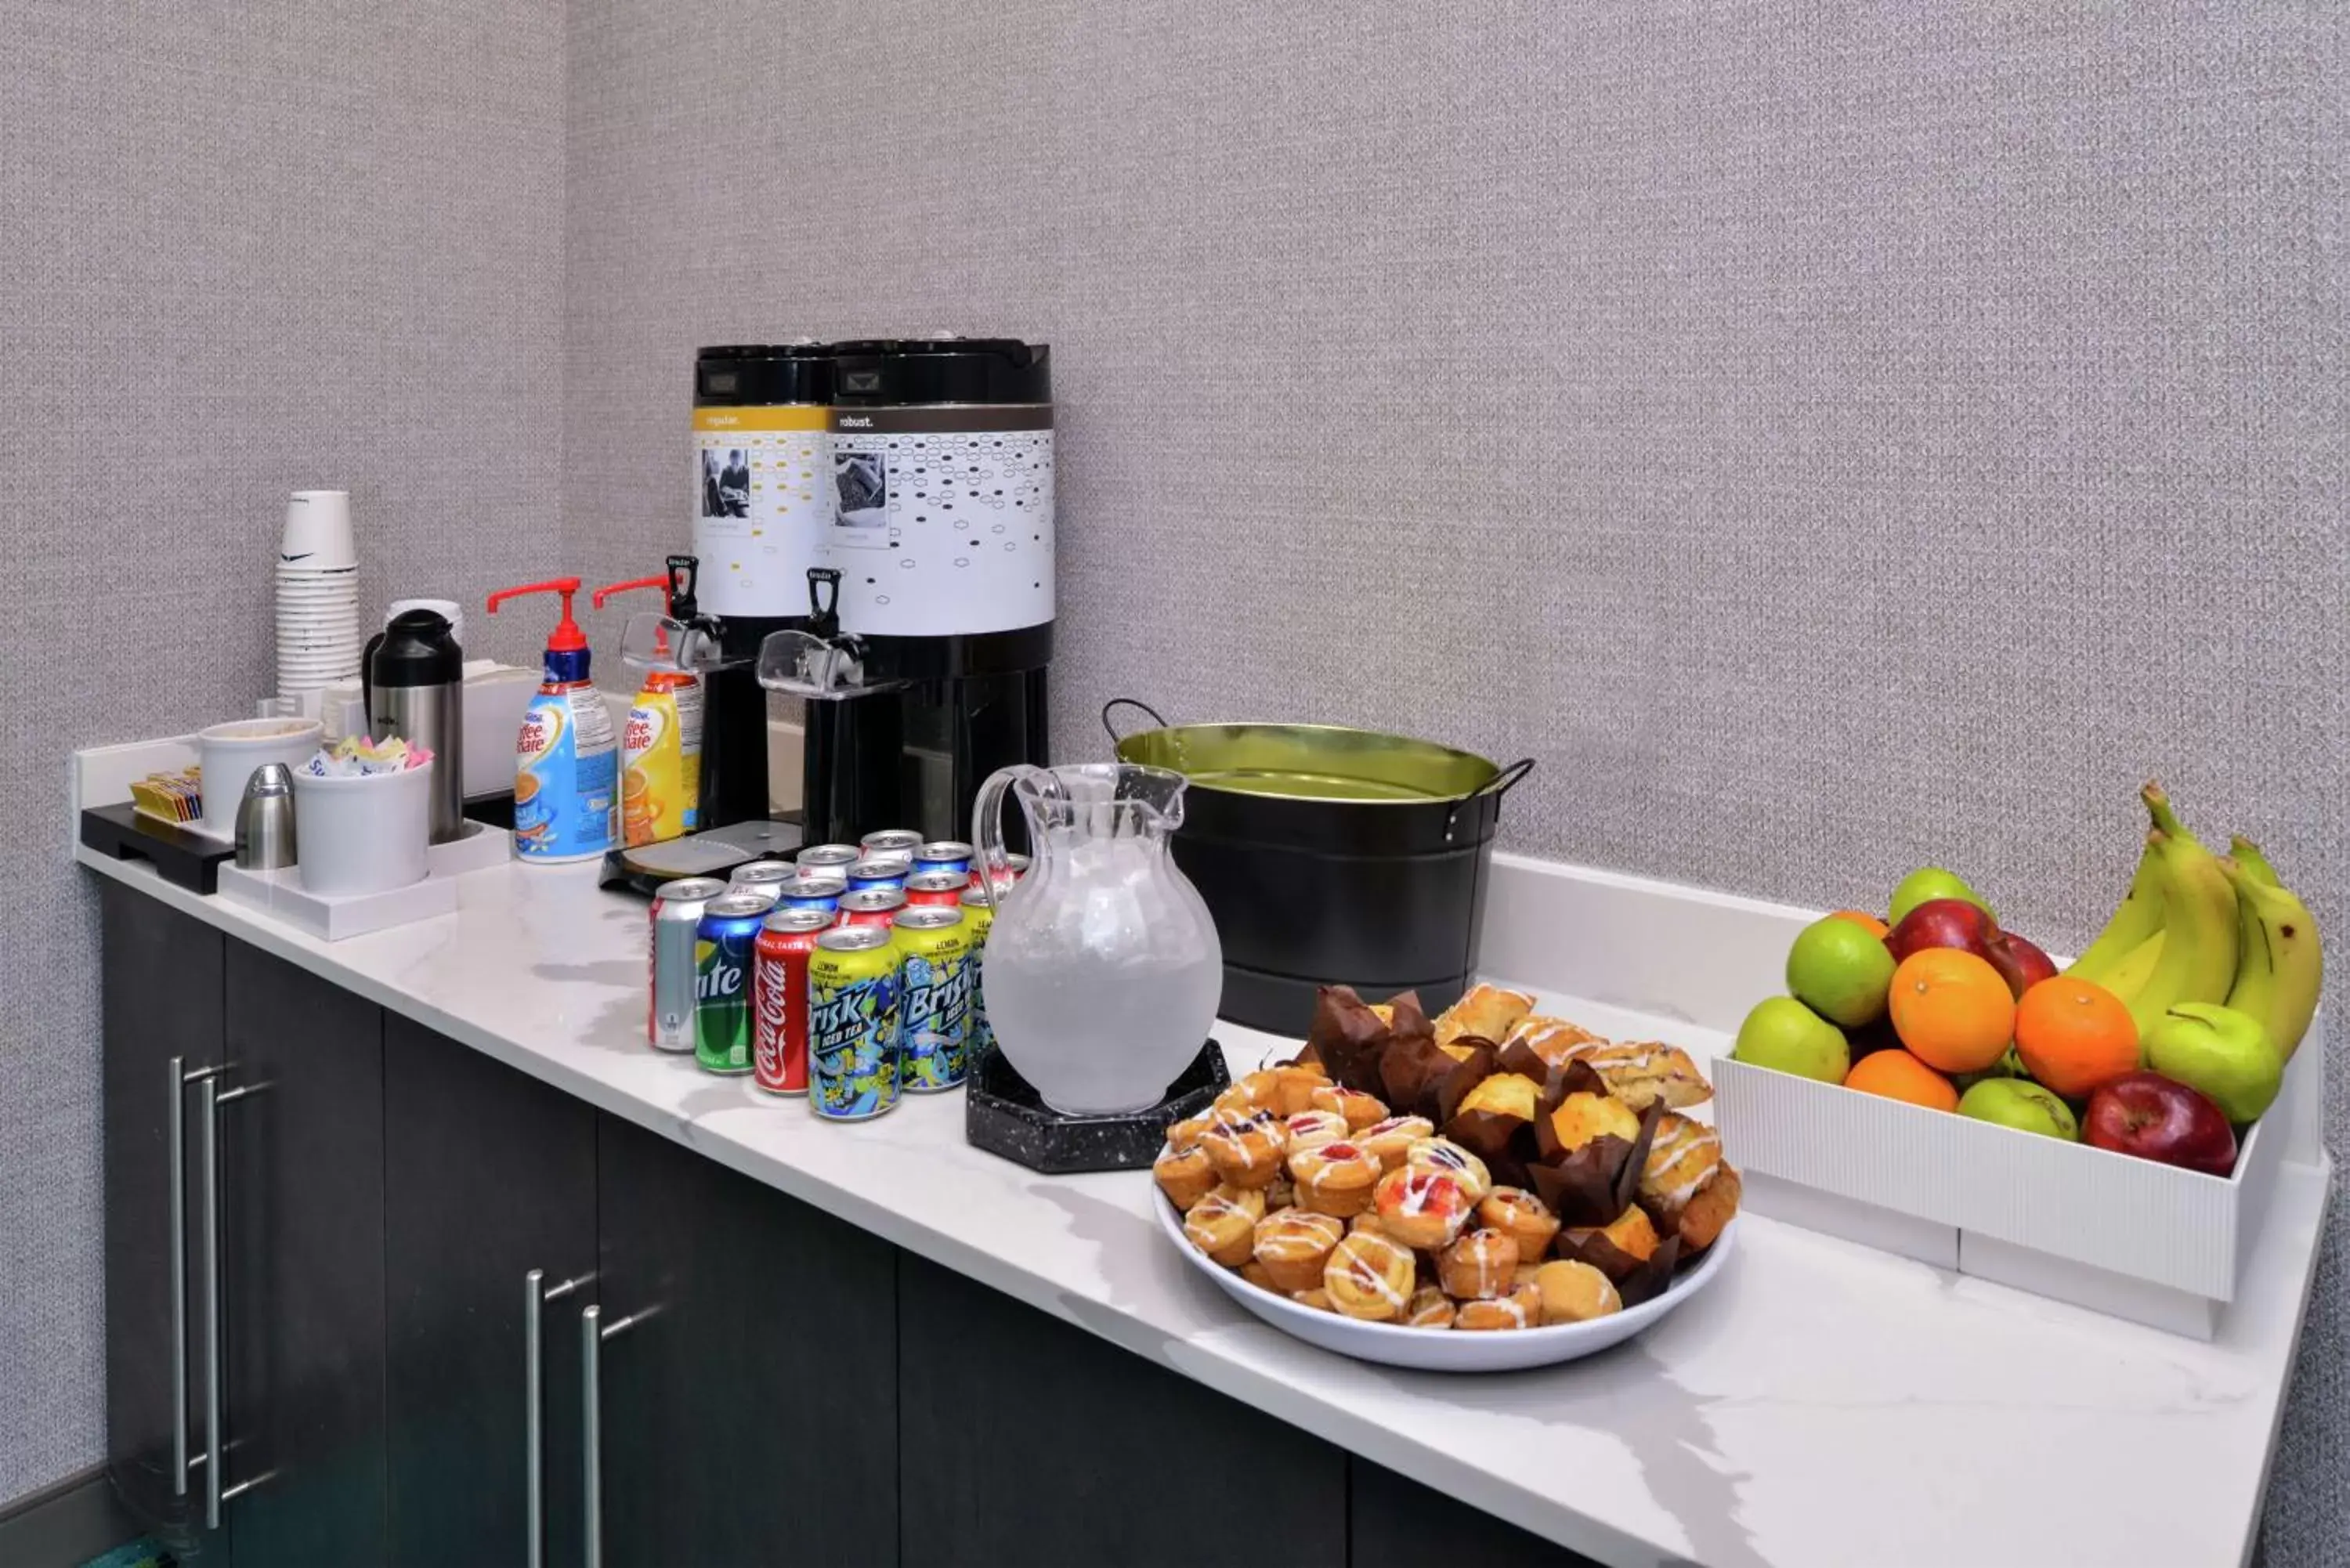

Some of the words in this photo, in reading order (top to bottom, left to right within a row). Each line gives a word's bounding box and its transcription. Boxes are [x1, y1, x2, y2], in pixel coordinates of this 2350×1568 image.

[840, 416, 873, 428] robust.
[936, 938, 960, 950] LEMON
[817, 961, 839, 972] LEMON
[811, 992, 864, 1035] risk
[822, 1030, 843, 1048] ICED
[845, 1021, 863, 1039] TEA
